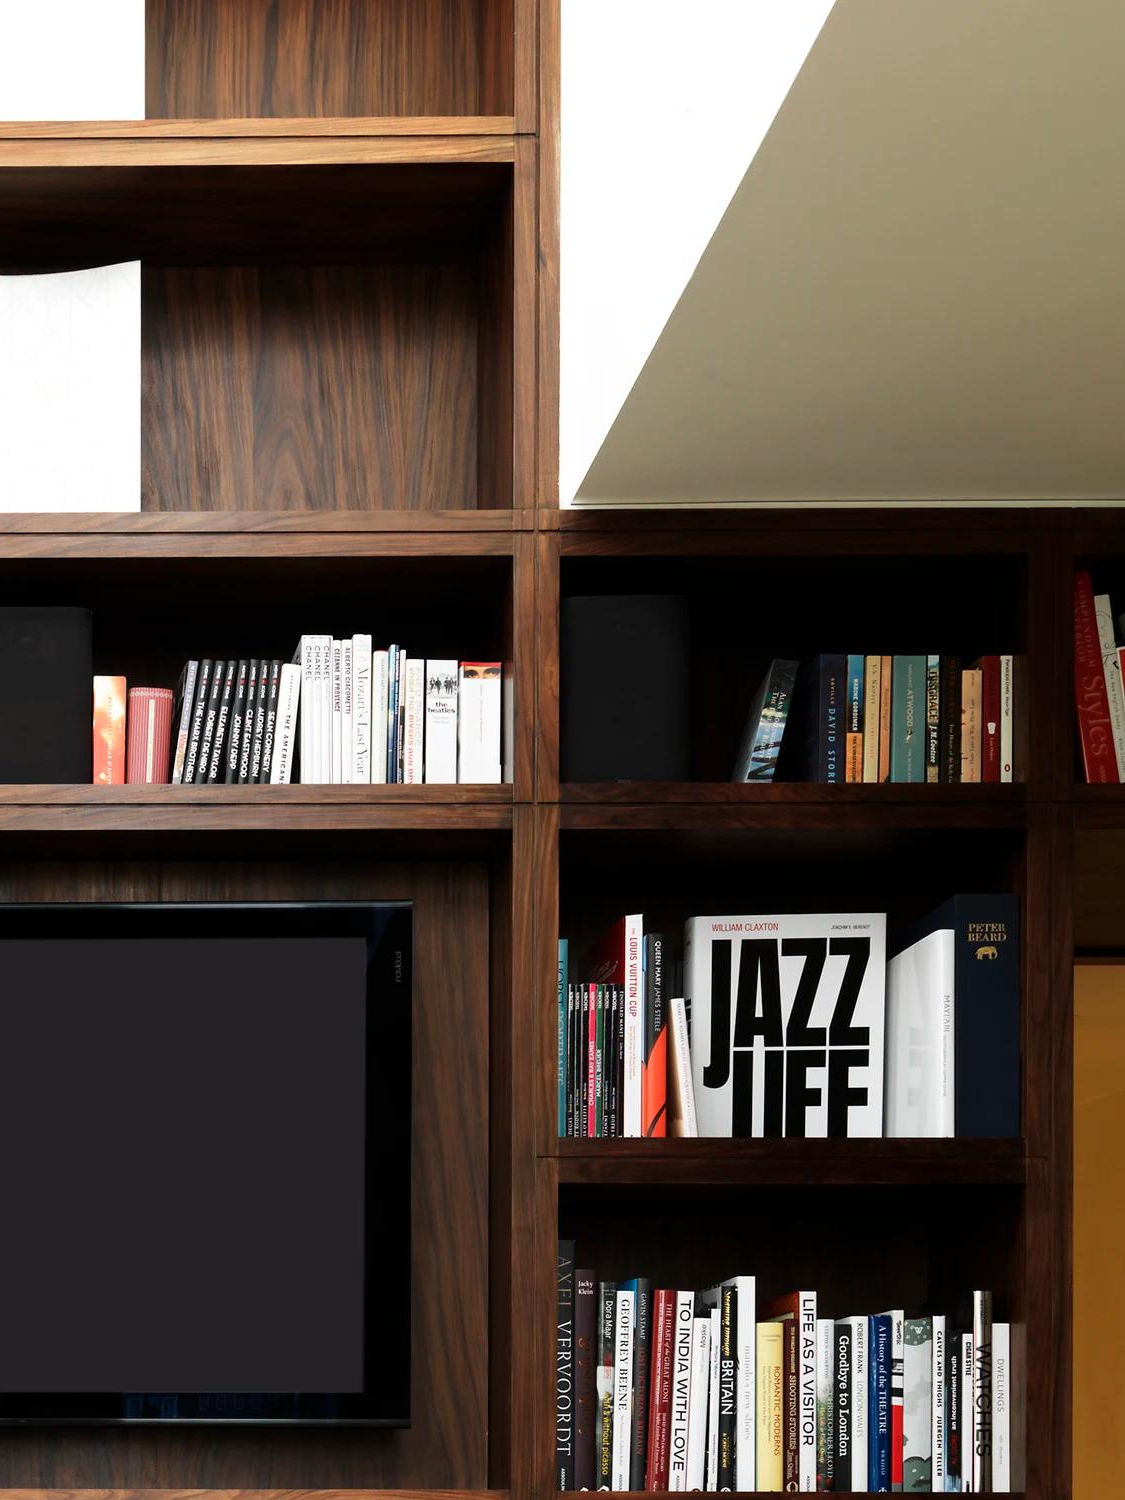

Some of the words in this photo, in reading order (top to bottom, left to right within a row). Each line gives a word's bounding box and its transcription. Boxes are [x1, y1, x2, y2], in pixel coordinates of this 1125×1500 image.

[344, 647, 352, 674] ALBERTO
[344, 677, 352, 714] GIACOMETTI
[356, 668, 369, 719] Mozart's
[905, 689, 914, 727] ATWOOD
[245, 709, 254, 732] CLINT
[255, 707, 265, 739] AUDREY
[267, 711, 276, 732] SEAN
[827, 708, 837, 743] DAVID
[1079, 674, 1110, 757] Styles
[262, 733, 273, 772] CONNERY
[356, 723, 368, 747] Last
[239, 733, 251, 778] EASTWOOD
[251, 740, 262, 777] HEPBURN
[356, 749, 368, 775] Year
[711, 923, 743, 932] WILLIAM
[745, 923, 779, 931] CLAXTON
[968, 923, 1006, 933] PETER
[968, 932, 1007, 942] BEARD
[629, 937, 638, 961] LOUIS
[629, 964, 638, 998] VUITTON
[629, 1001, 637, 1017] CUP
[702, 936, 871, 1089] JAZZ
[679, 1300, 692, 1321] TO
[803, 1299, 814, 1333] LIFE
[619, 1299, 630, 1364] GEOFFREY
[803, 1338, 814, 1359] AS
[878, 1334, 886, 1362] History
[678, 1327, 690, 1373] INDIA
[838, 1335, 849, 1389] Goodbye
[803, 1364, 814, 1376] A
[879, 1365, 886, 1374] of
[557, 1320, 571, 1456] VERVOORDT
[618, 1369, 628, 1410] BEENE
[675, 1378, 688, 1422] WITH
[721, 1360, 733, 1415] BRITAIN
[839, 1393, 848, 1405] to
[976, 1342, 991, 1457] WATCHES
[803, 1381, 814, 1446] VISITOR
[673, 1428, 686, 1471] LOVE
[839, 1409, 849, 1456] London
